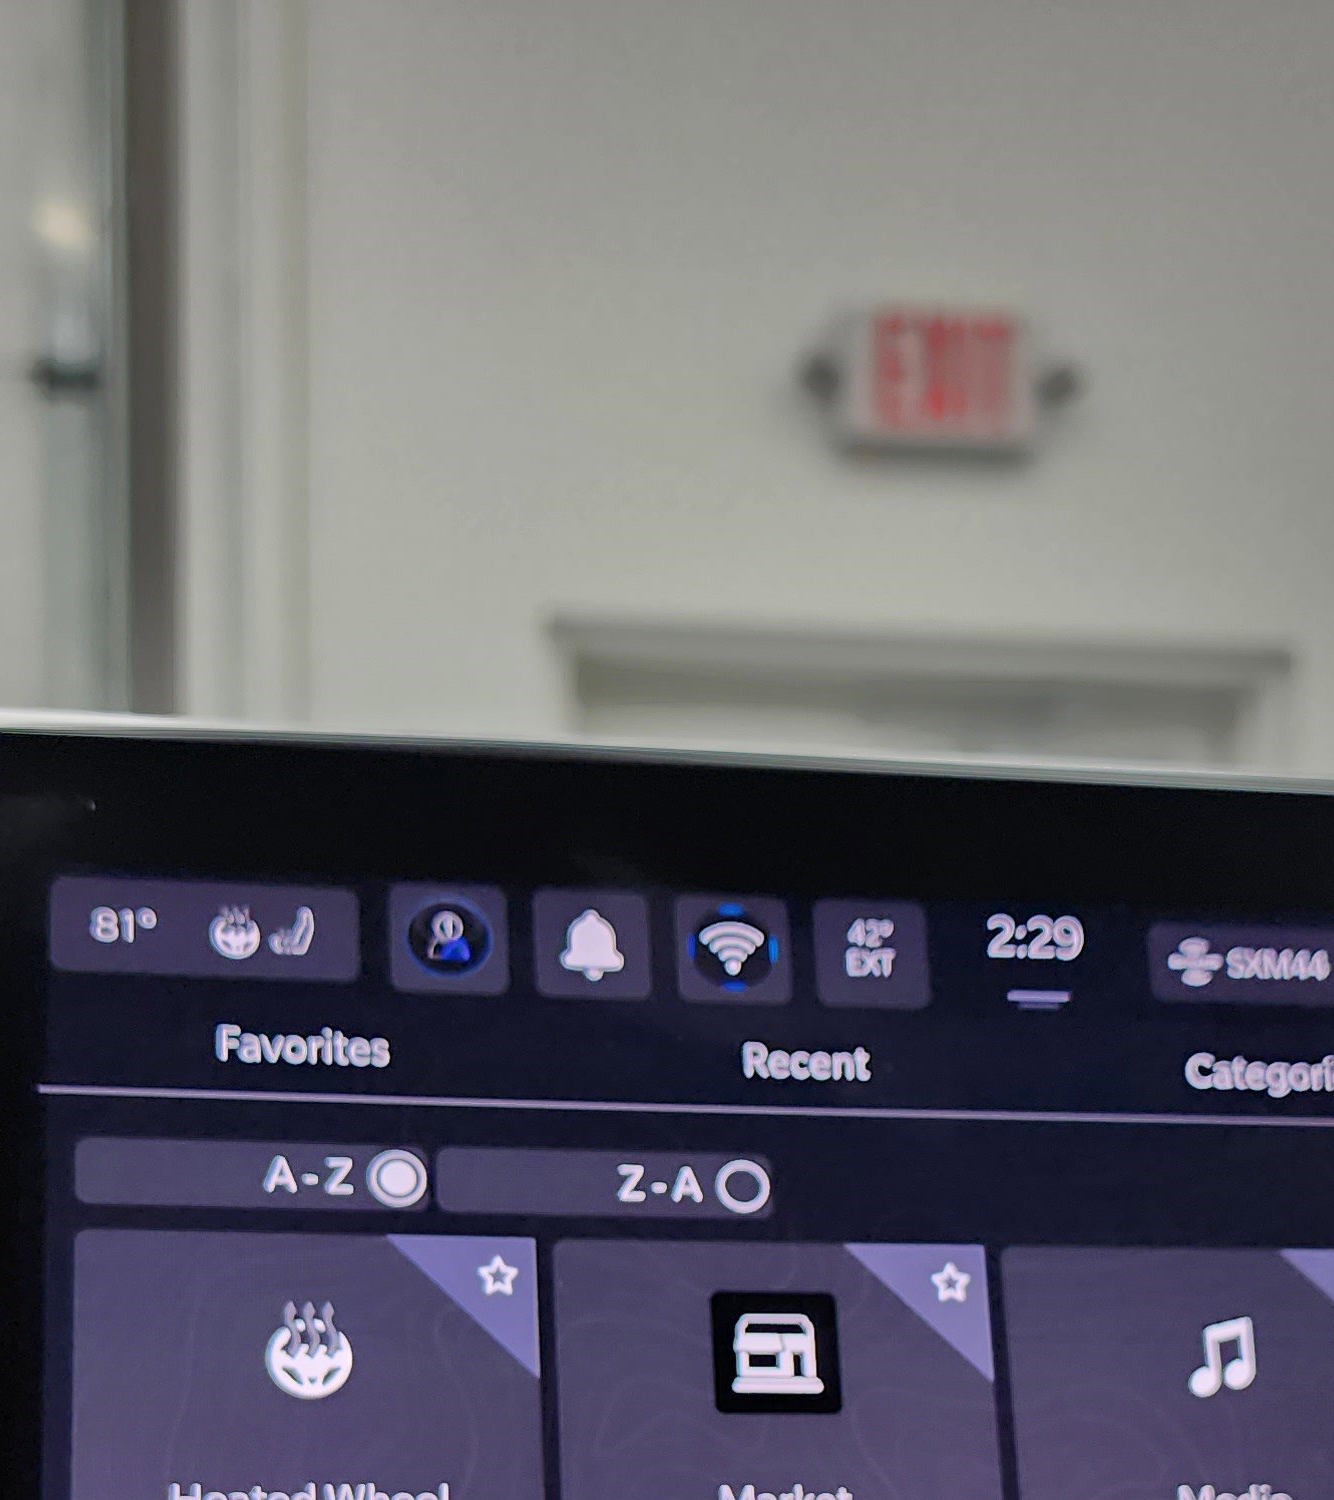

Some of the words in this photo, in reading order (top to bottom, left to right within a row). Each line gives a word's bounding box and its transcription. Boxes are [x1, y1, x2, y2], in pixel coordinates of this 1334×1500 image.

[986, 913, 1085, 962] 2:29
[845, 946, 896, 978] EXT
[215, 1023, 391, 1068] Favorites
[742, 1041, 872, 1082] Recent
